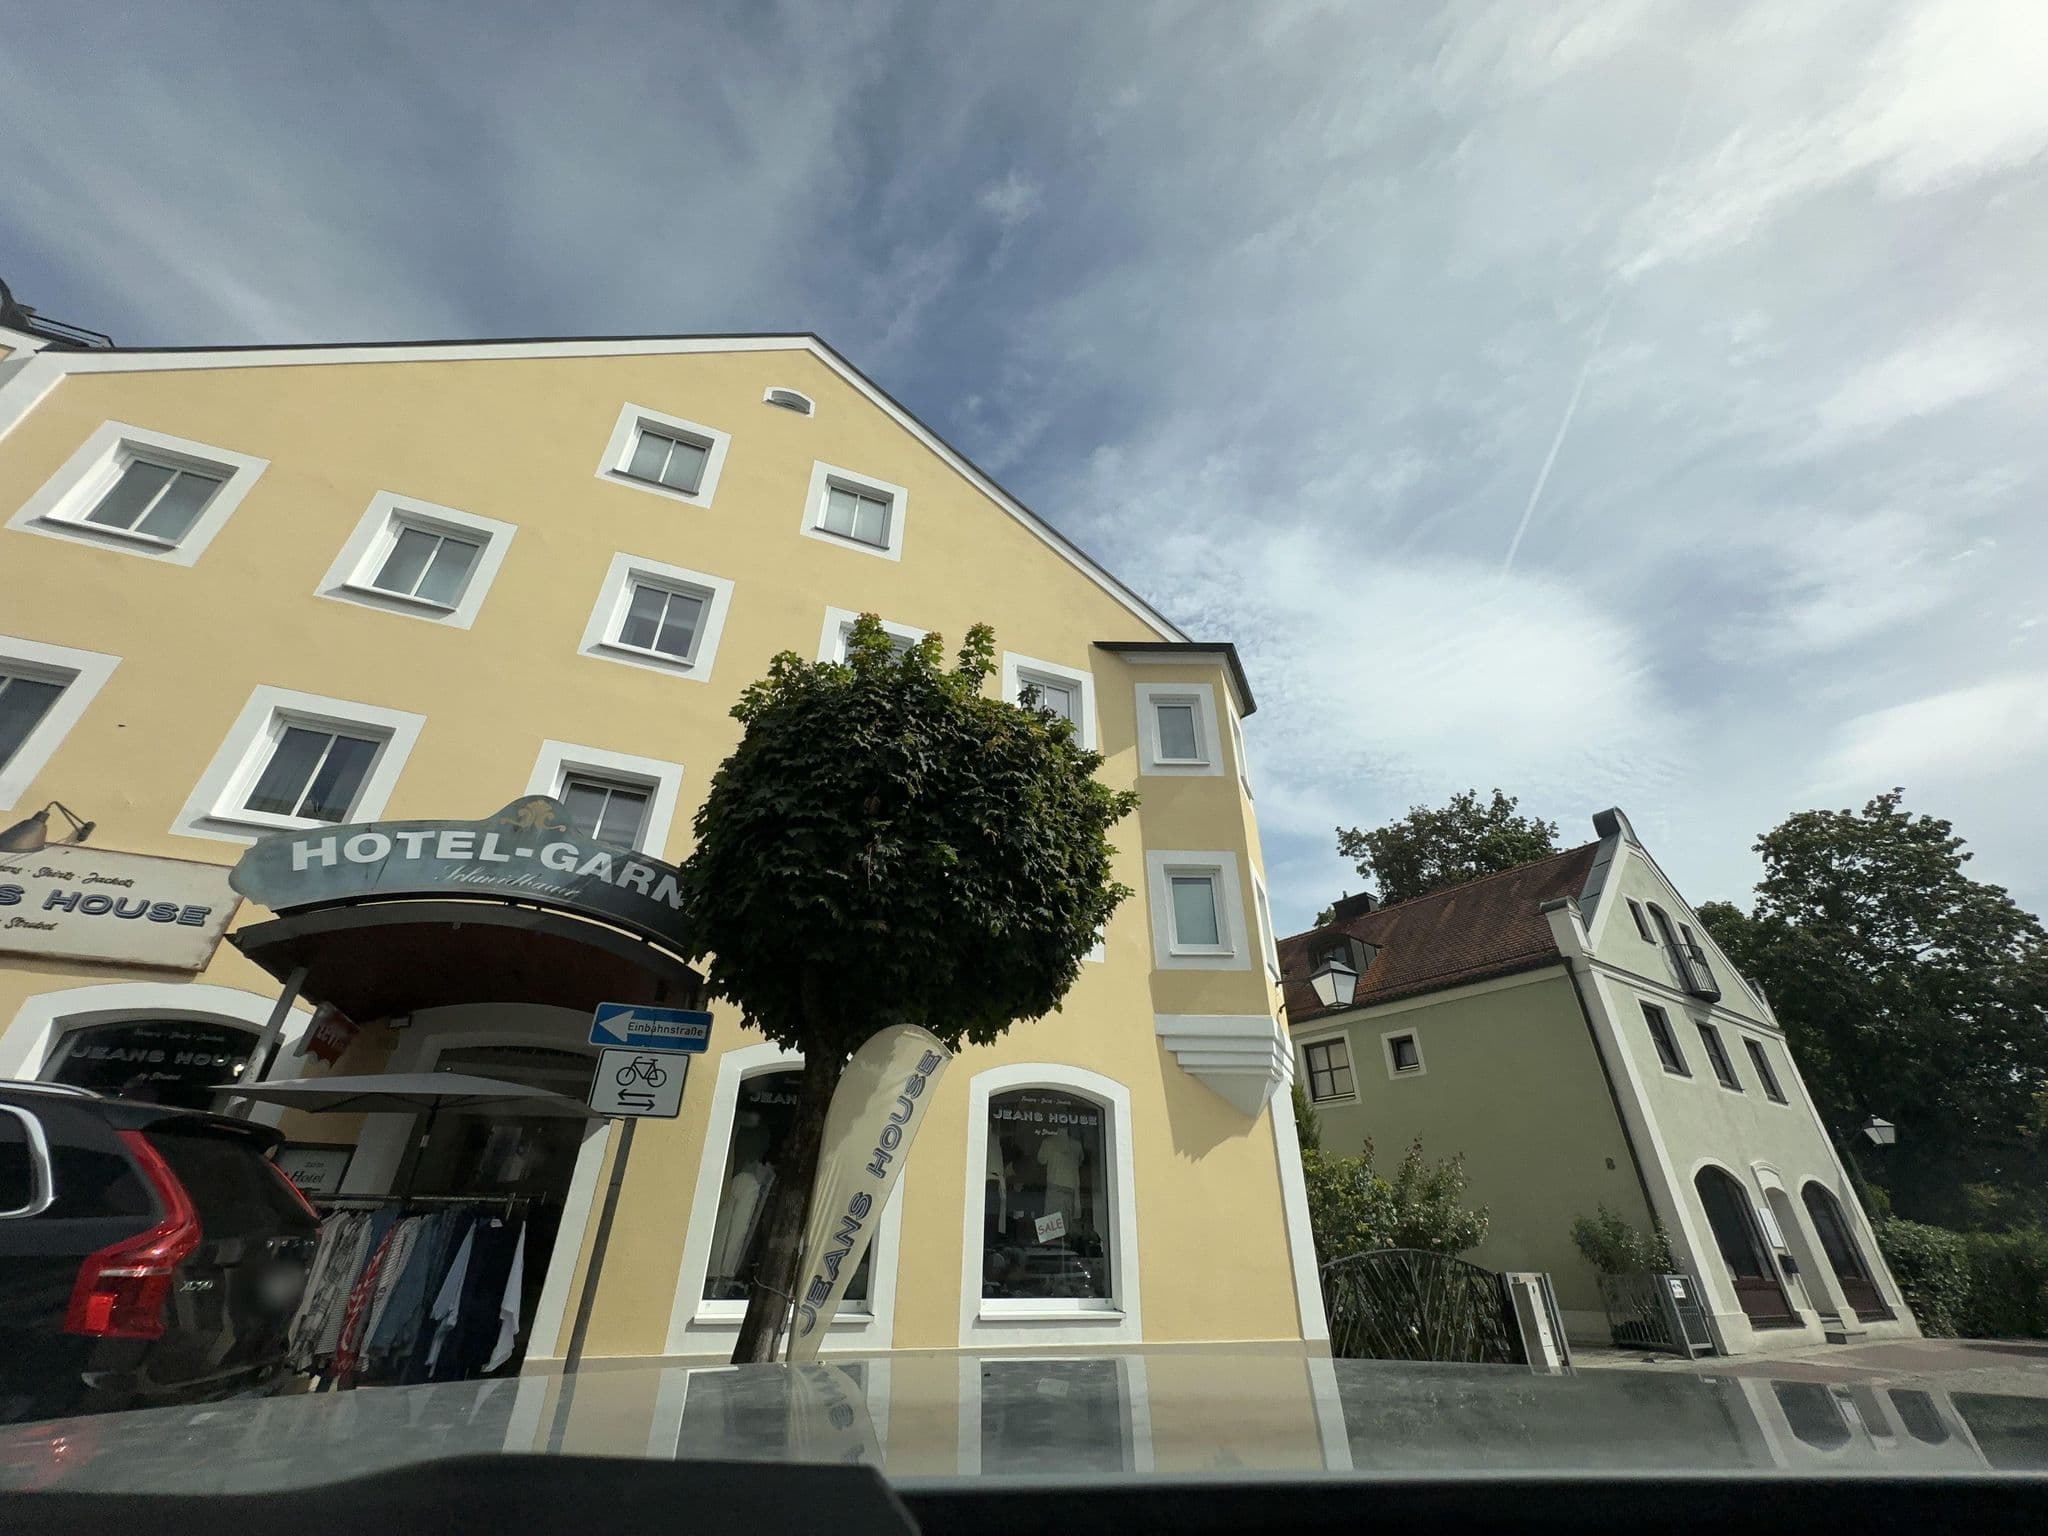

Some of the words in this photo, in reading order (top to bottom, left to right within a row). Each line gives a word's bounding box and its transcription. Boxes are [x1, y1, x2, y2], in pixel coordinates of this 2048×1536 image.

[81, 872, 135, 888] Jackets
[42, 889, 212, 927] HOUSE
[627, 1022, 704, 1037] Einbahnstraße
[750, 1090, 799, 1105] JEAN
[992, 1107, 1043, 1122] JEANS
[1048, 1111, 1098, 1127] HOUSE
[290, 1170, 325, 1184] Hotel
[799, 1191, 874, 1338] JEANS
[865, 1049, 943, 1179] HOUSE
[1038, 1217, 1063, 1236] SALE
